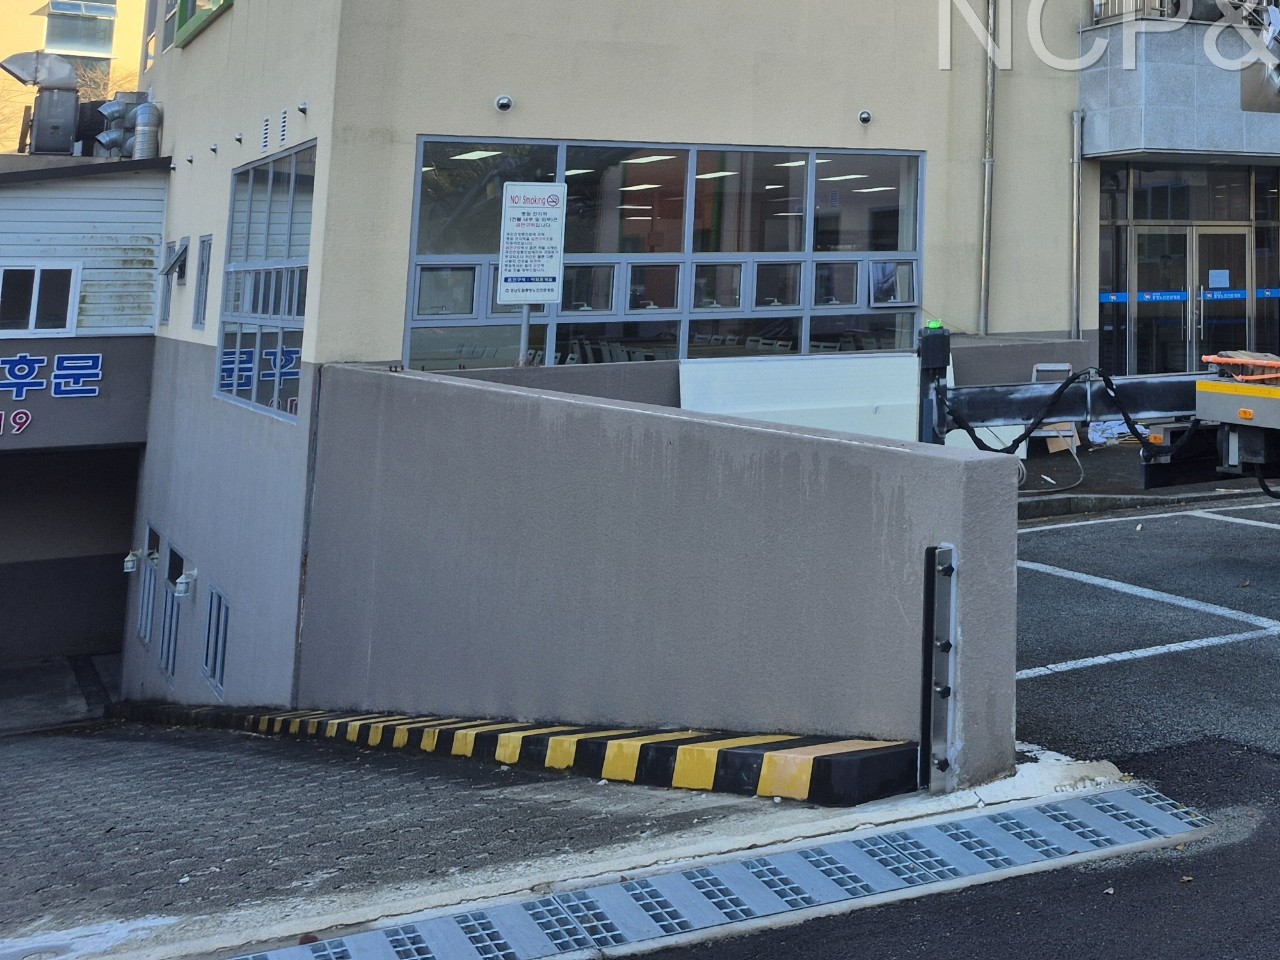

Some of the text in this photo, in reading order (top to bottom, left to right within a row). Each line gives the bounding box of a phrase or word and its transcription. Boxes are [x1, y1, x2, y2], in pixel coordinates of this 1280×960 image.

[510, 194, 546, 206] NO! Smoking
[0, 353, 103, 400] 후문
